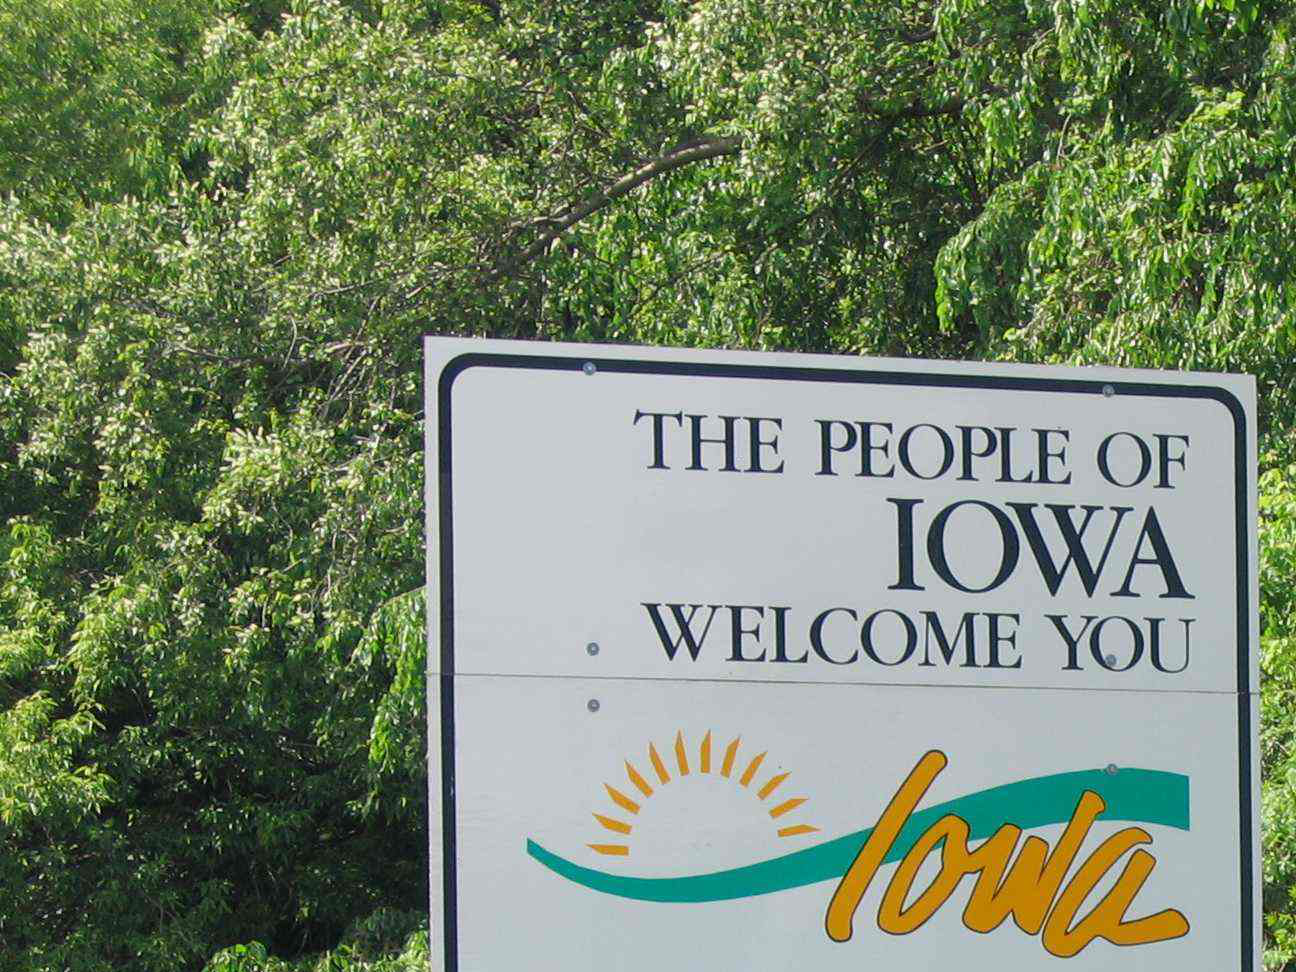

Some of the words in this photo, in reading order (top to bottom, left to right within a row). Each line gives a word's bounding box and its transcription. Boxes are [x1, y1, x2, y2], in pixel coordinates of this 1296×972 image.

[633, 409, 785, 474] THE
[814, 419, 1072, 486] PEOPLE
[1096, 431, 1190, 489] OF
[886, 497, 1197, 600] IOWA
[641, 602, 1022, 669] WELCOME
[1043, 614, 1197, 674] YOU
[825, 750, 1190, 959] Iowa
